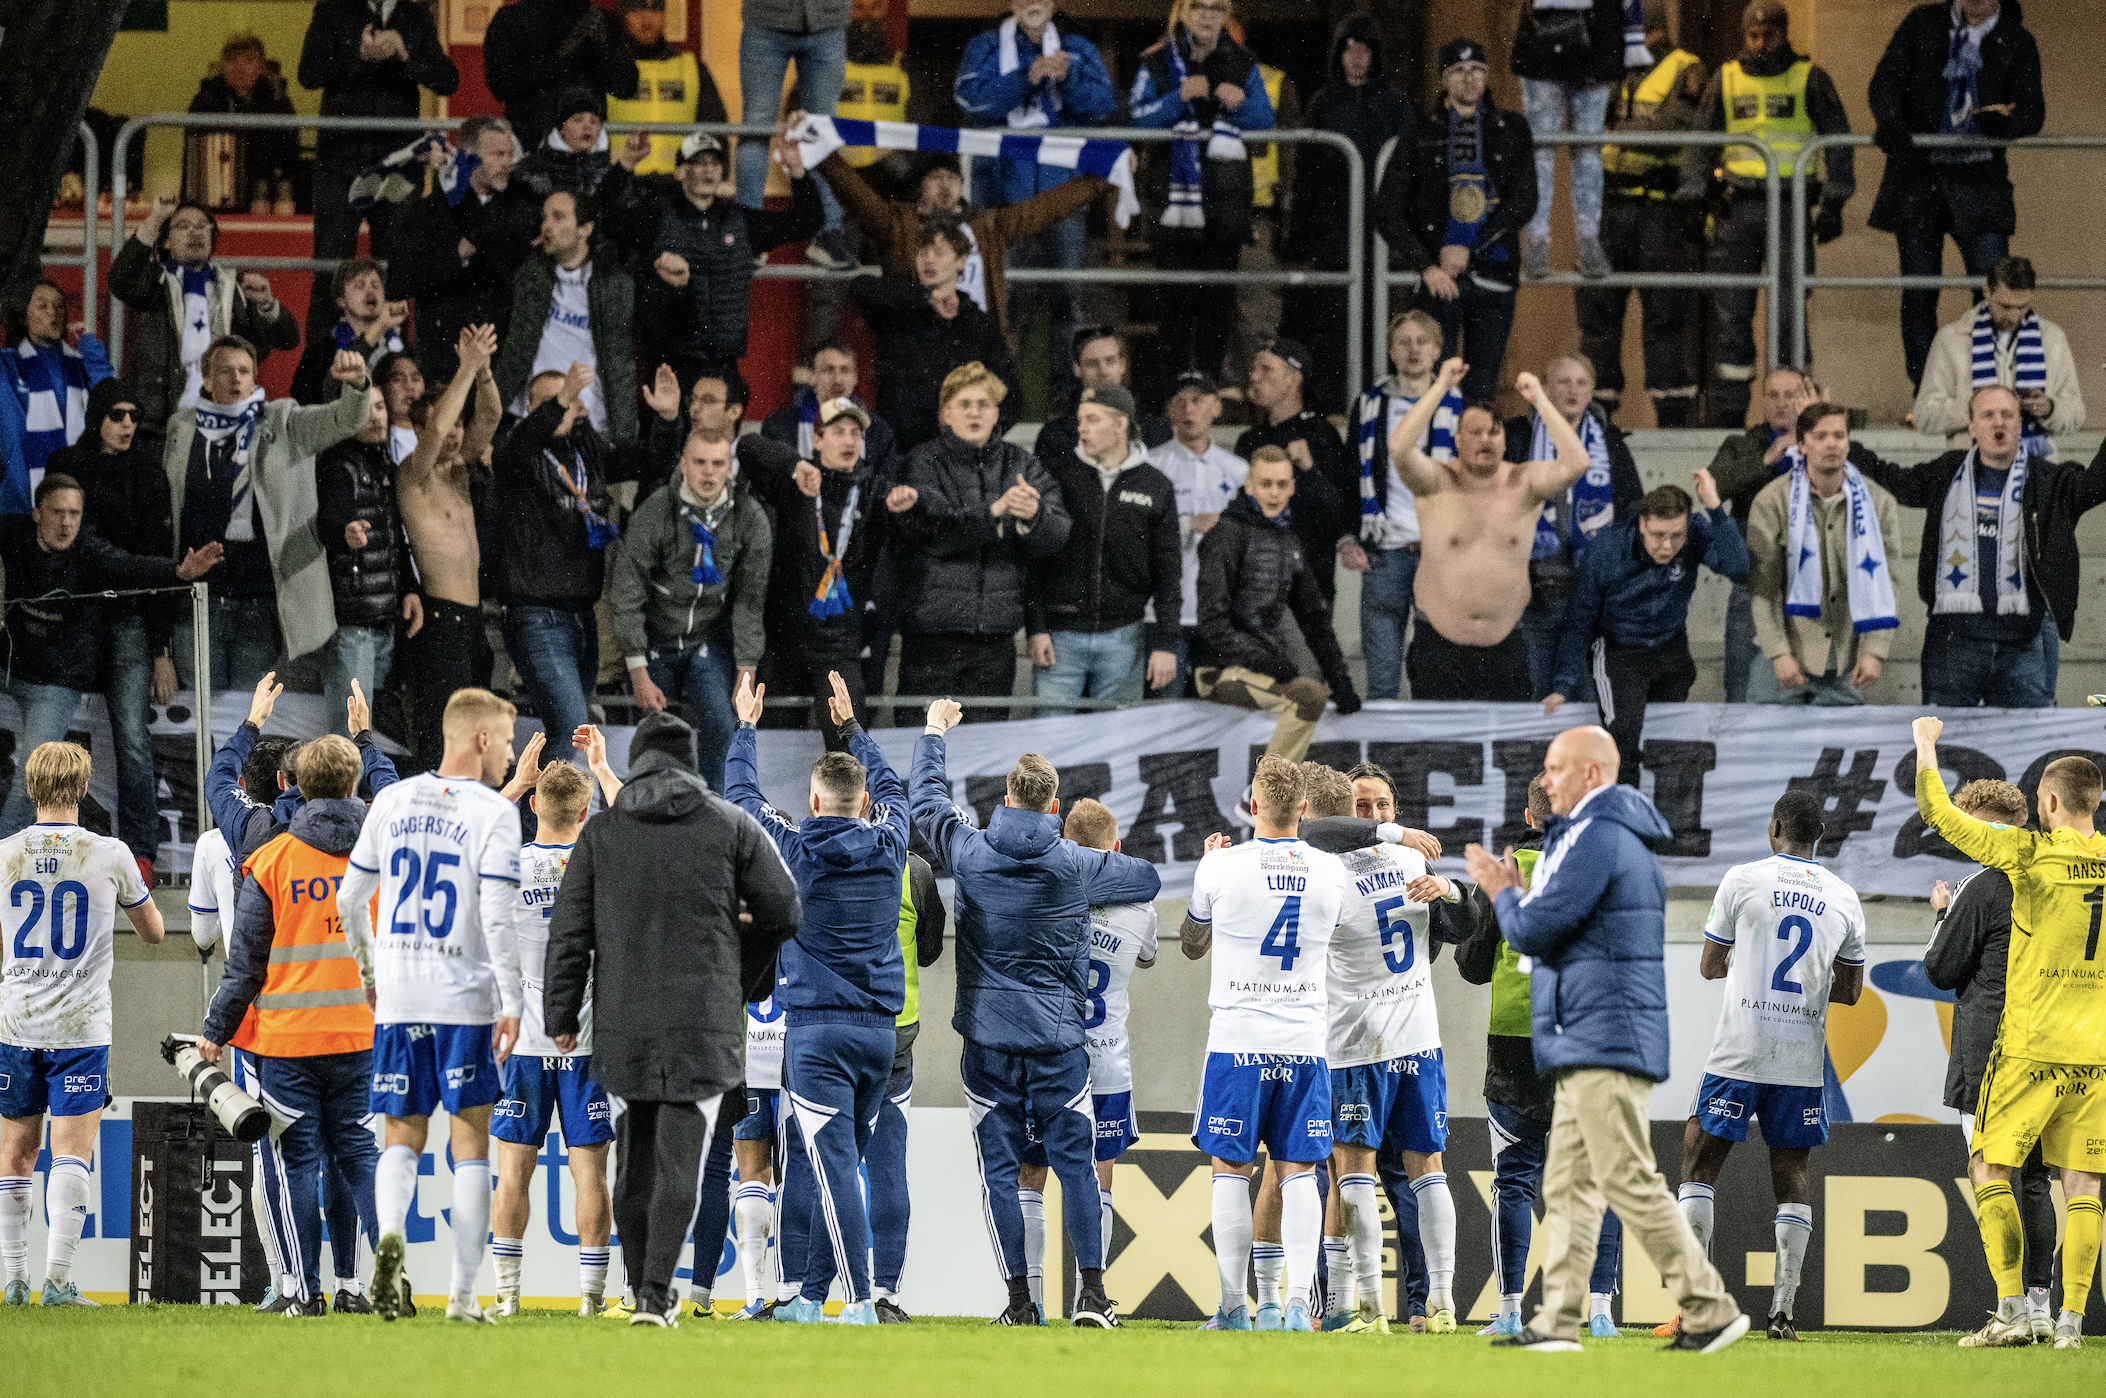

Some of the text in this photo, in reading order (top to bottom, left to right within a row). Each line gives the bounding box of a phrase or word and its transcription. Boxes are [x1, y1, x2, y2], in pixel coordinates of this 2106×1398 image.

[1119, 490, 1153, 507] NASA
[35, 858, 58, 874] EID
[1260, 863, 1309, 873] Norrköping
[1355, 860, 1397, 876] Norrköping
[1267, 875, 1307, 892] LUND
[1355, 870, 1406, 897] NYMAN
[1777, 876, 1824, 893] Norrköping
[390, 847, 461, 938] 25
[1773, 891, 1827, 916] EKPOLO
[10, 880, 89, 960] 20
[2083, 885, 2105, 961] 1
[1091, 930, 1122, 953] SON
[1260, 896, 1302, 971] 4
[1374, 895, 1415, 974] 5
[1771, 915, 1813, 995] 2
[65, 1075, 86, 1085] pre
[1260, 1063, 1294, 1083] RÖR
[64, 1085, 93, 1093] zero
[1708, 1106, 1731, 1117] zero
[1097, 1120, 1118, 1130] pre
[1208, 1116, 1225, 1126] pre
[1307, 1120, 1324, 1129] pre
[1097, 1129, 1124, 1138] zero
[1208, 1126, 1231, 1136] zero
[1307, 1129, 1328, 1137] zero
[205, 1160, 213, 1184] SONY
